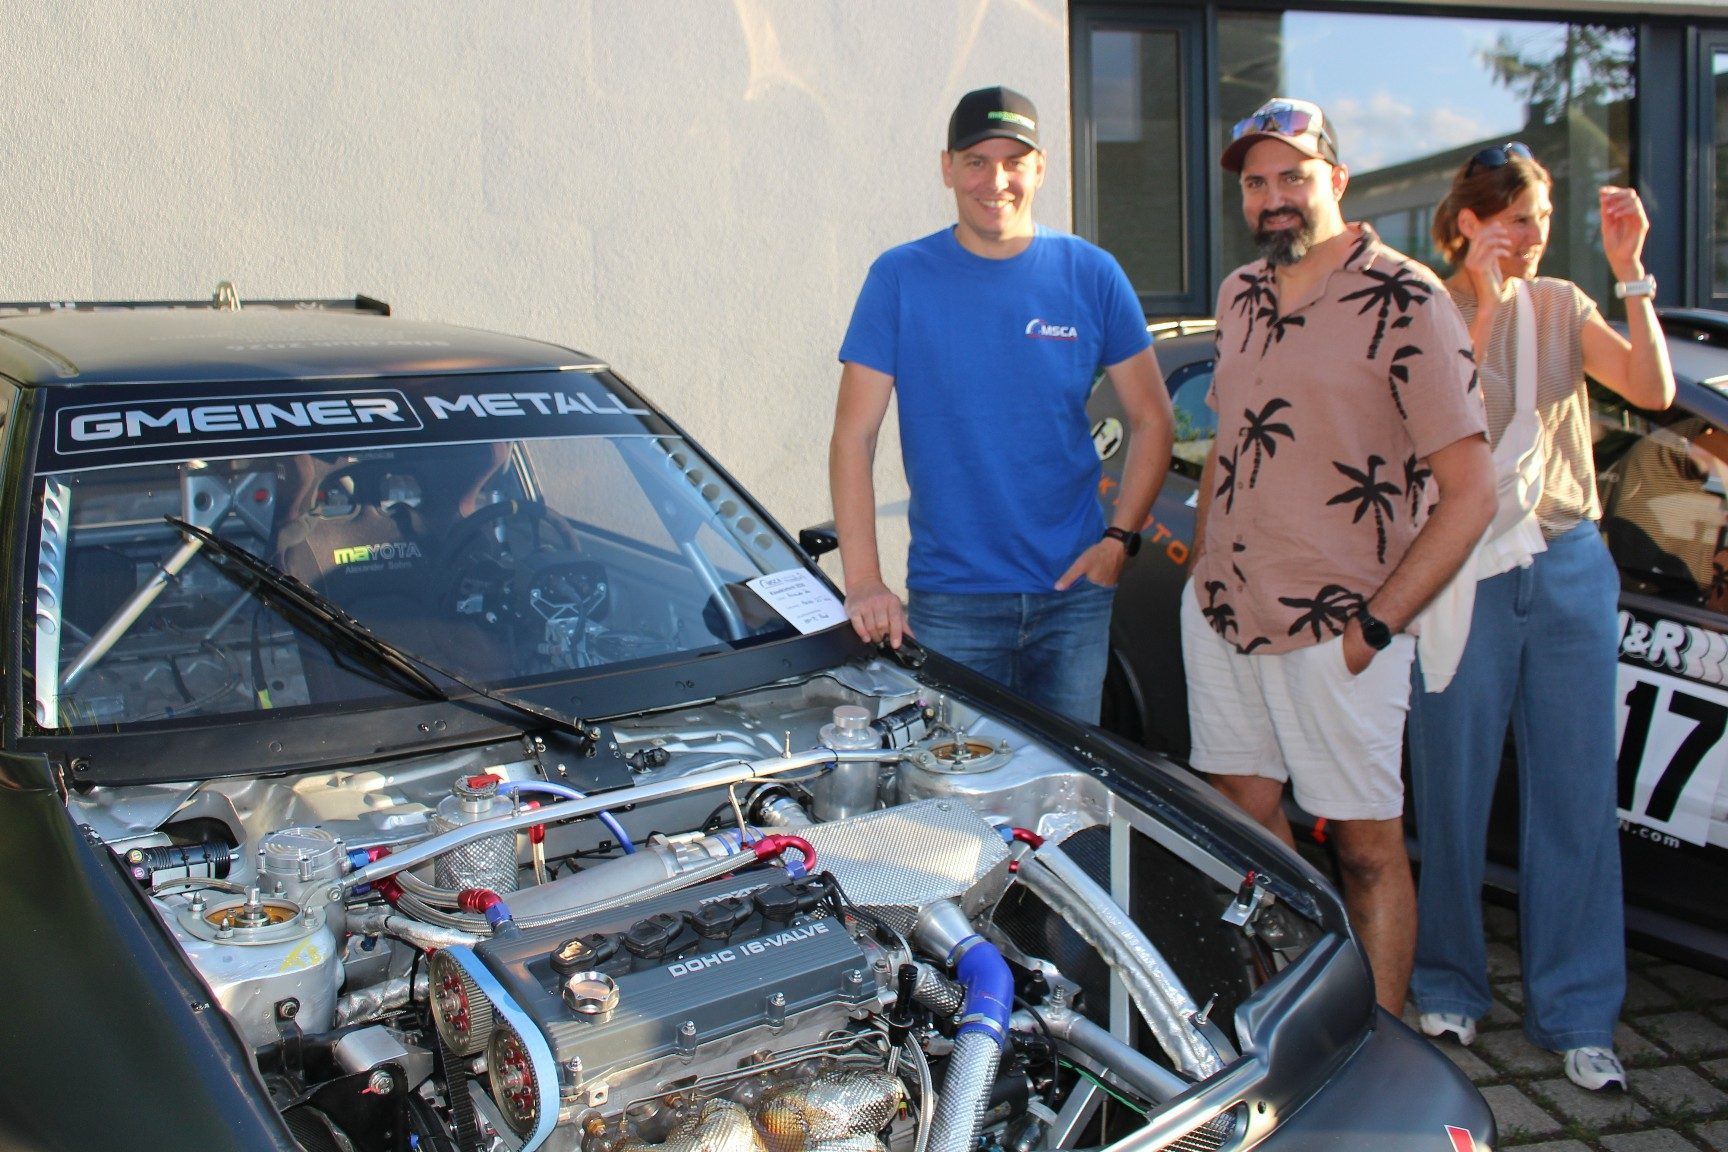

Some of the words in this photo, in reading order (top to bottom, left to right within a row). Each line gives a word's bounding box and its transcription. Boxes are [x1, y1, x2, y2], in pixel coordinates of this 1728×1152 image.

[70, 398, 404, 442] GMEINER
[424, 391, 650, 420] METALL
[1617, 680, 1728, 823] 17
[667, 949, 737, 979] DOHC
[740, 922, 830, 957] 16-VALVE
